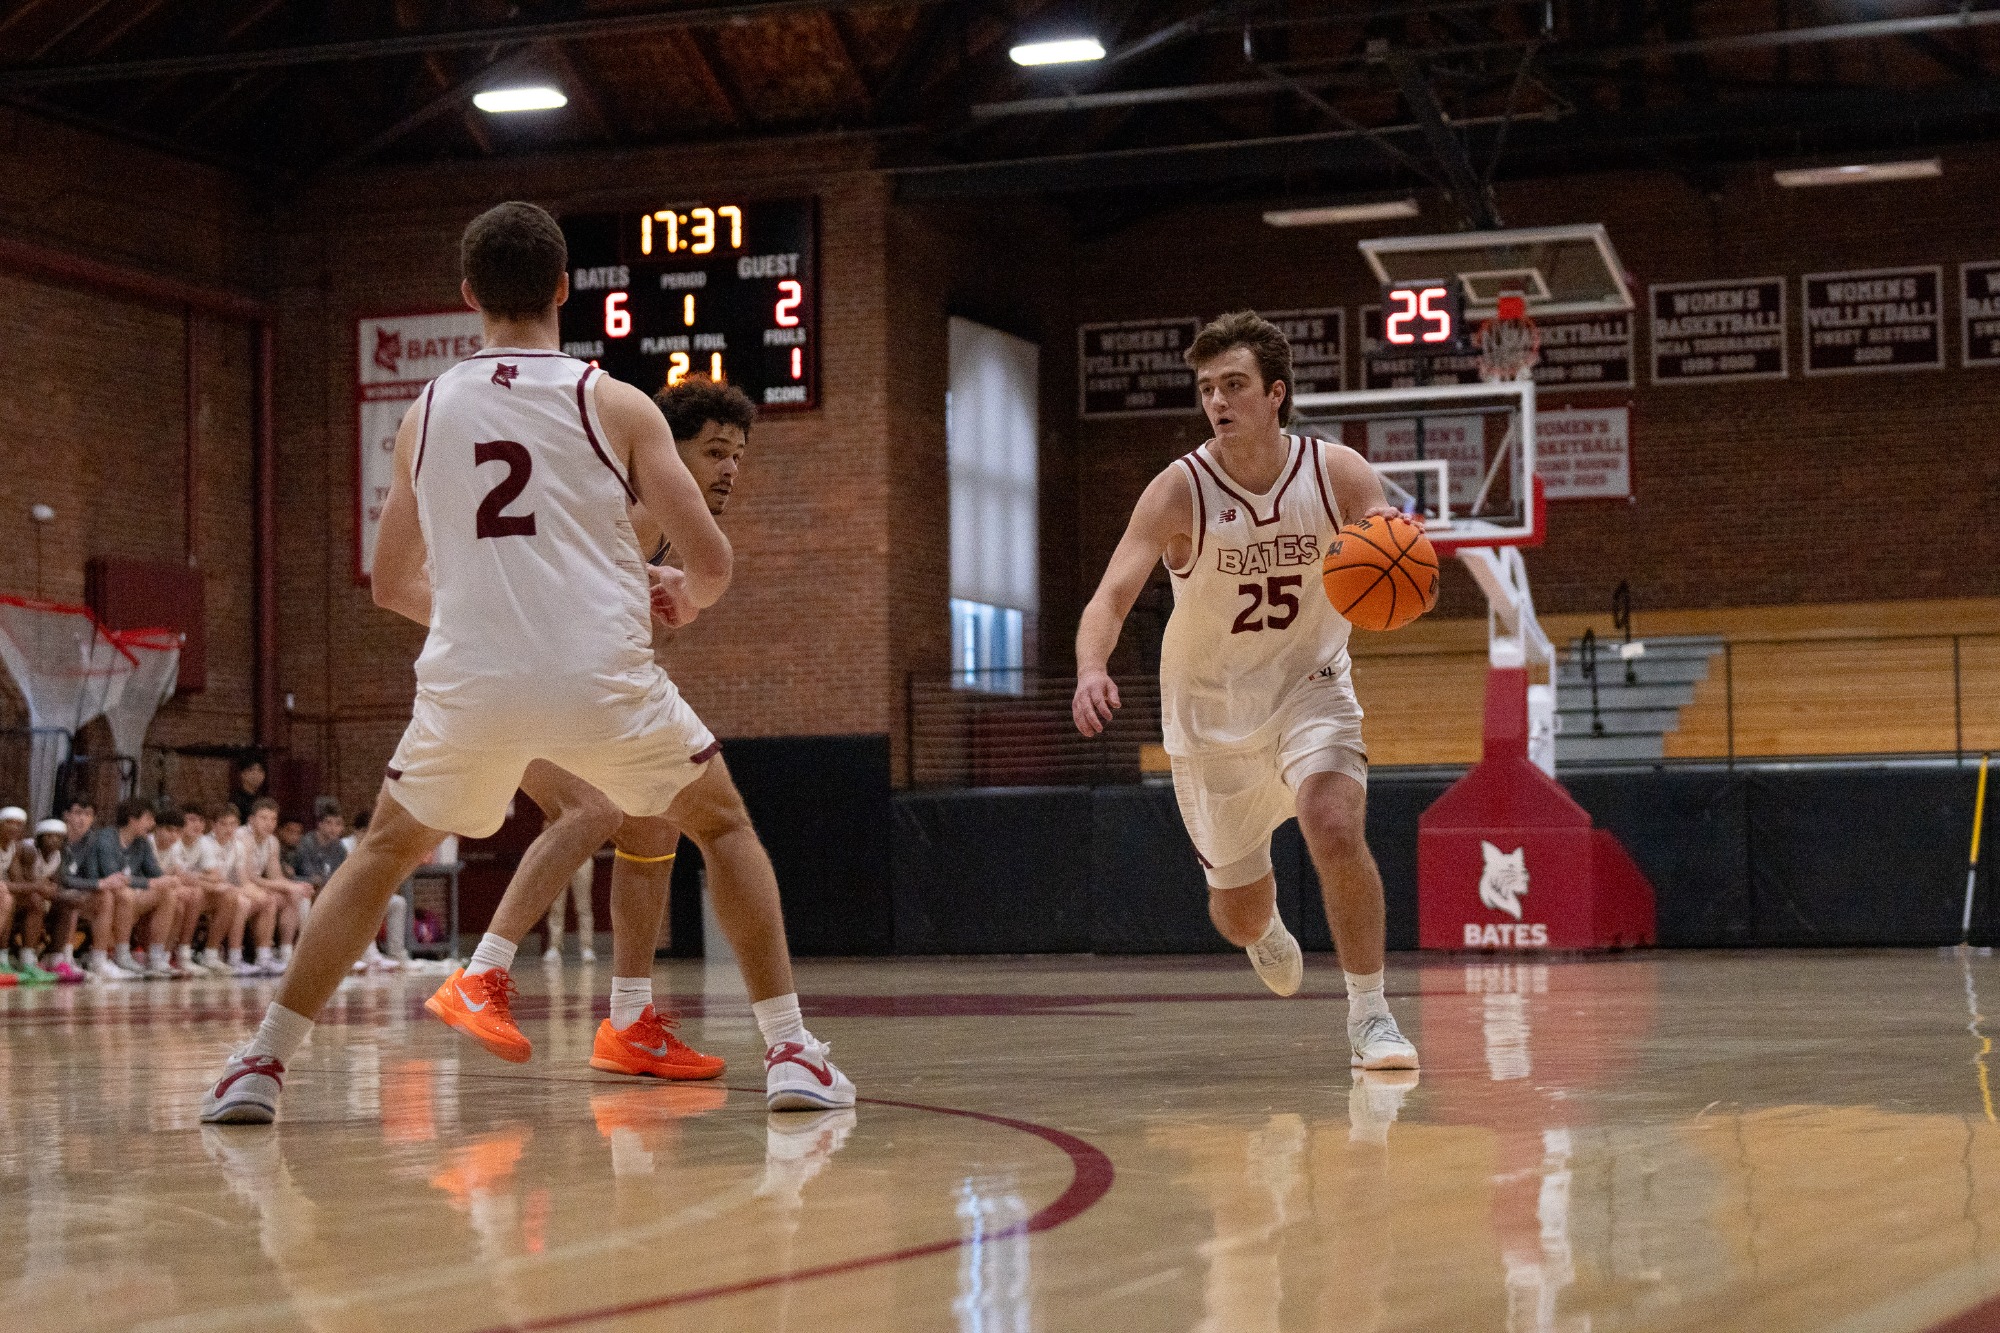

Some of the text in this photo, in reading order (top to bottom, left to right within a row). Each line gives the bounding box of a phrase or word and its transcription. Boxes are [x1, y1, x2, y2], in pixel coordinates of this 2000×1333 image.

[641, 205, 742, 256] 17:37
[574, 265, 631, 291] BATES
[659, 271, 707, 290] PERIOD
[737, 253, 801, 279] GUEST
[605, 292, 632, 338] 6
[683, 293, 695, 327] 1
[775, 280, 802, 328] 2
[1386, 287, 1450, 344] 25
[407, 335, 482, 360] BATES
[563, 340, 604, 357] FOULS
[640, 333, 728, 354] PLAYER FOUL
[763, 327, 806, 346] FOULS
[791, 346, 802, 380] 1
[764, 386, 807, 403] SCORE
[474, 440, 537, 539] 2
[1217, 535, 1321, 576] BATES
[1230, 574, 1303, 635] 25
[1463, 922, 1549, 948] BATES
